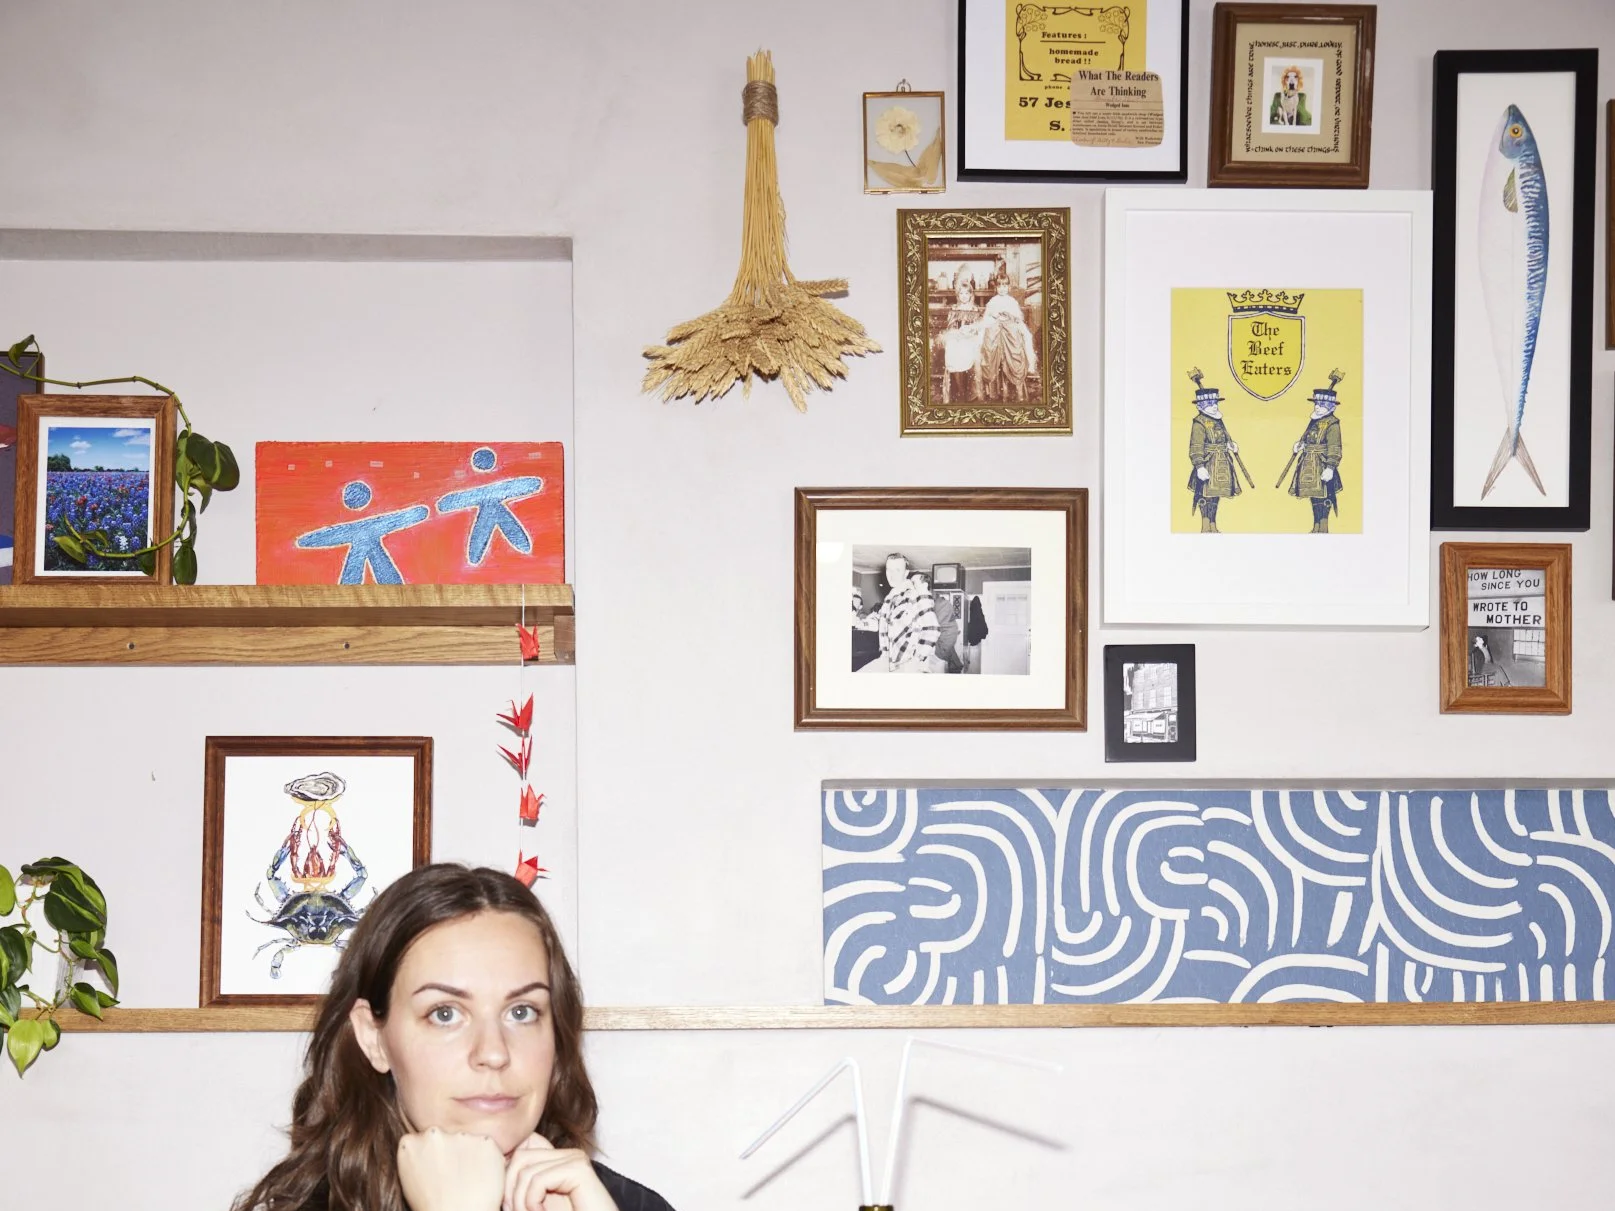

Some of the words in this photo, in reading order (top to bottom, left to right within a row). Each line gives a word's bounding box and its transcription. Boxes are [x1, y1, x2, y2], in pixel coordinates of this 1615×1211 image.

[1049, 48, 1099, 57] homemade
[1079, 70, 1103, 81] What
[1104, 70, 1123, 81] The
[1125, 71, 1159, 82] Readers
[1090, 86, 1107, 97] Are
[1108, 86, 1147, 98] Thinking
[1018, 97, 1039, 108] 57
[1049, 120, 1065, 132] S.
[1251, 321, 1280, 341] The
[1247, 341, 1285, 357] Beef
[1240, 360, 1292, 380] Eaters
[1468, 572, 1489, 582] HOW
[1493, 569, 1521, 579] LONG
[1481, 581, 1511, 591] SINCE
[1517, 578, 1540, 588] YOU
[1473, 601, 1509, 612] WROTE
[1513, 601, 1528, 611] TO
[1486, 614, 1542, 626] MOTHER
